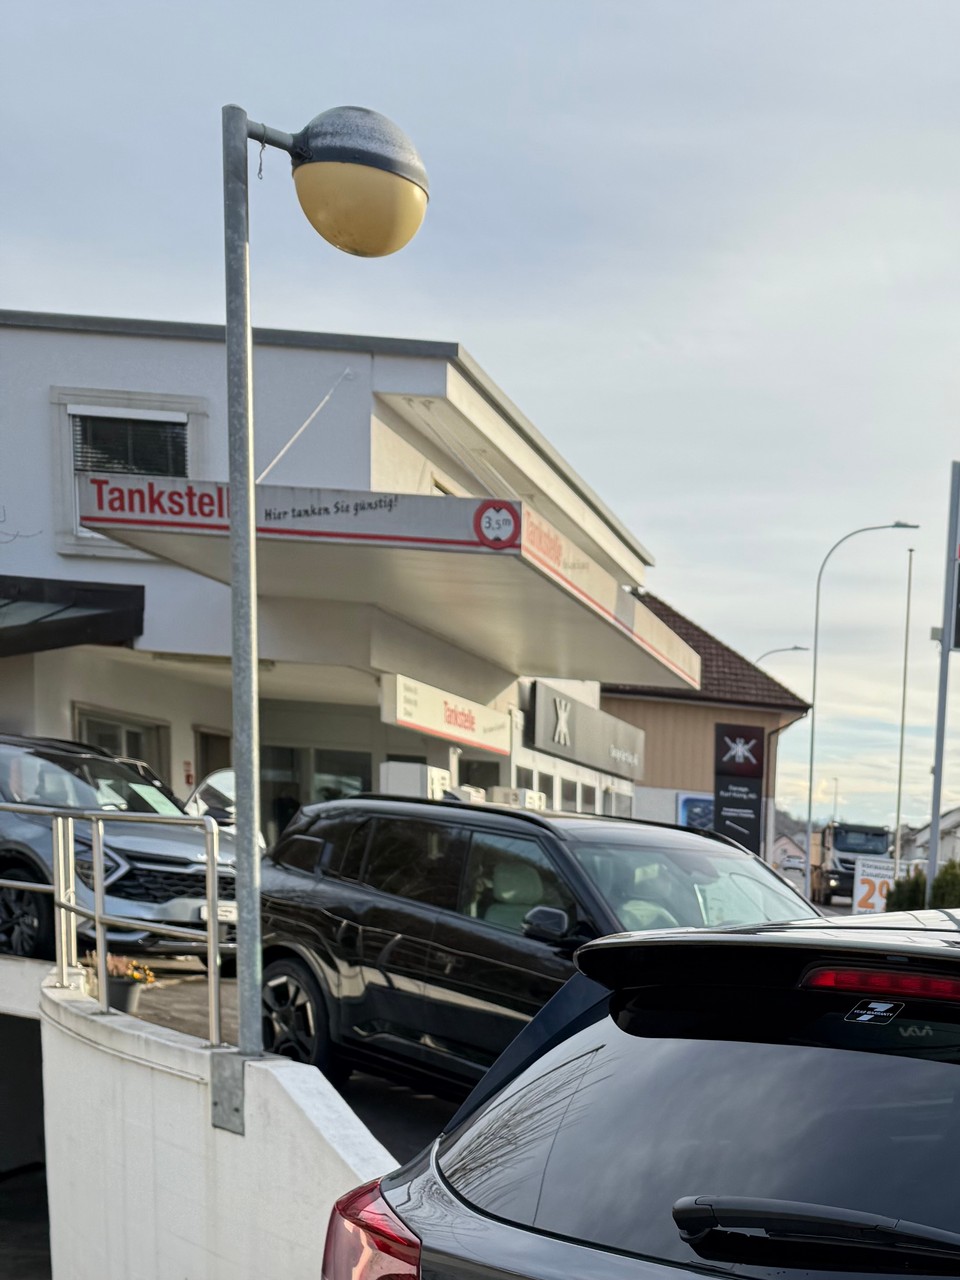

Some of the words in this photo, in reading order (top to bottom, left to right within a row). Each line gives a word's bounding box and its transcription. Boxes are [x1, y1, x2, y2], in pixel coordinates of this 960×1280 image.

[90, 478, 231, 519] Tankstell
[264, 507, 289, 521] Hier
[291, 504, 331, 519] tanken
[333, 500, 350, 514] Sie
